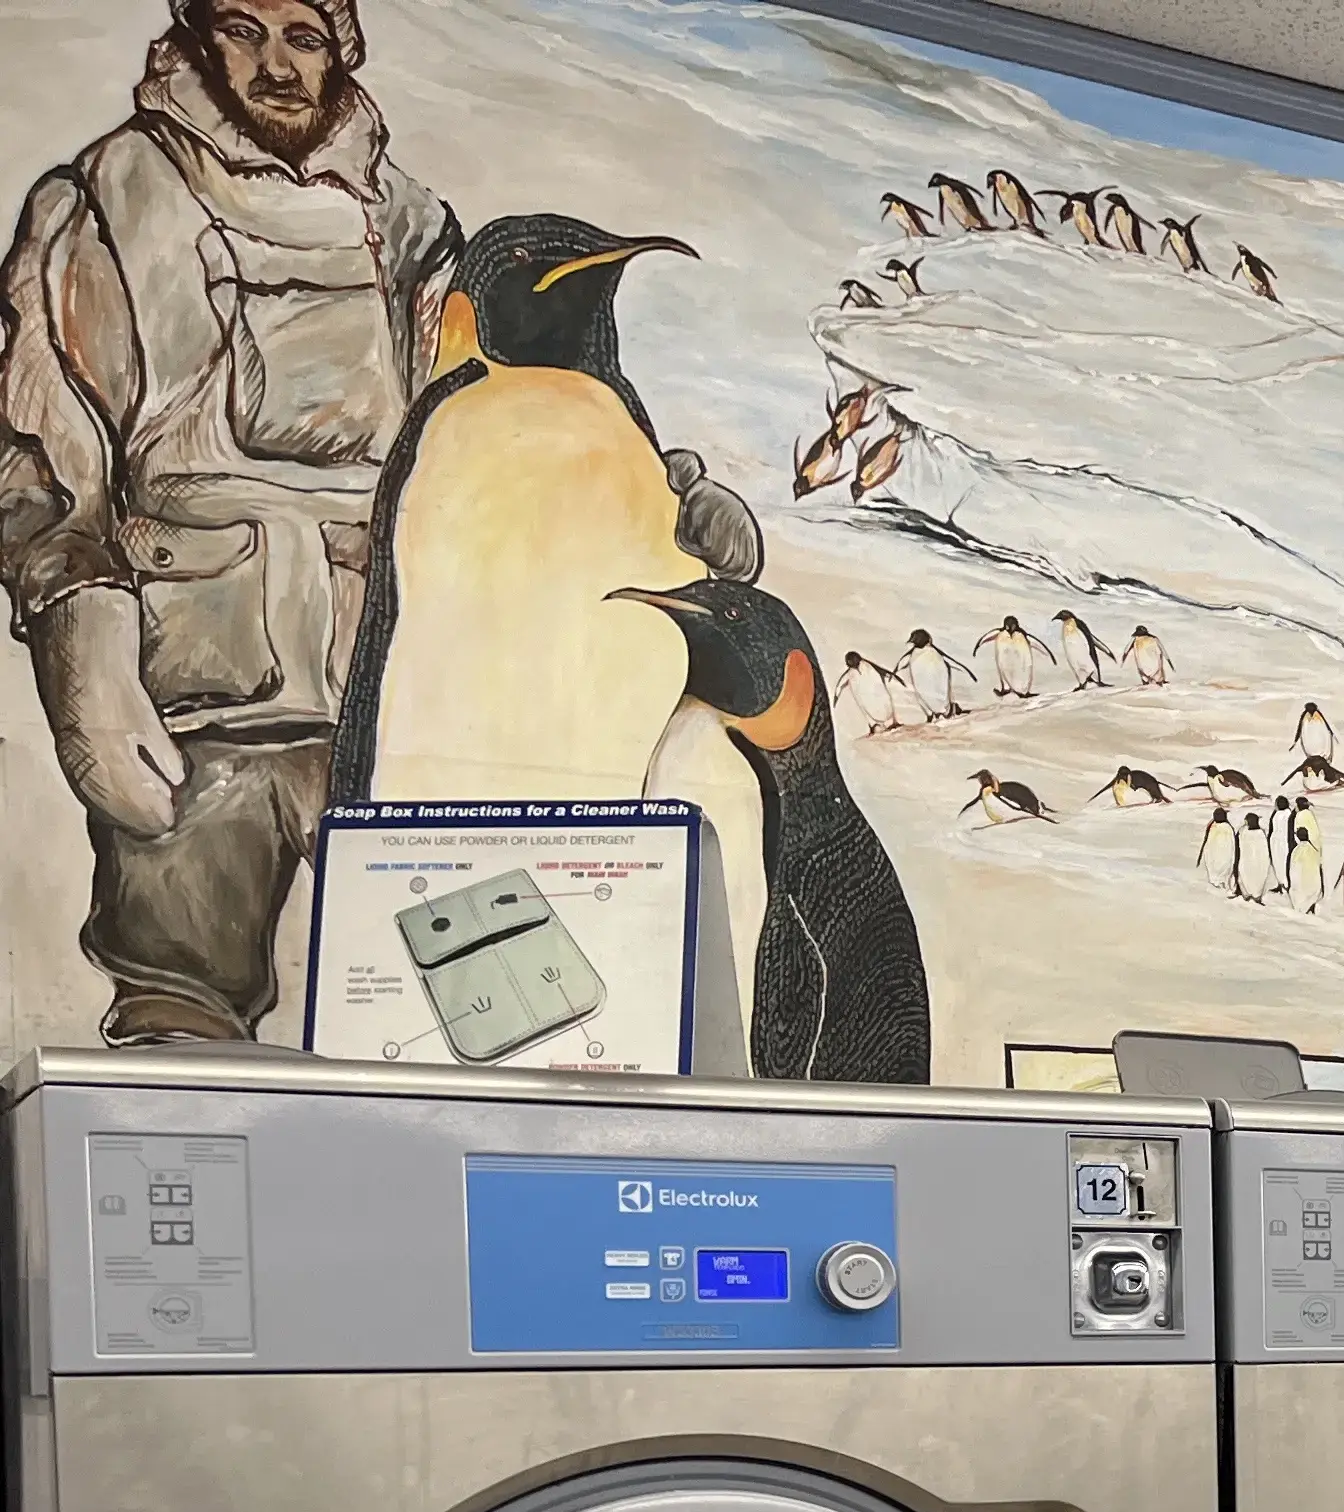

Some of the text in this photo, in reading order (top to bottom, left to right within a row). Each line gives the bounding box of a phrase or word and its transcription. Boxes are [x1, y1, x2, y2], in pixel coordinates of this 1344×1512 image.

[333, 803, 689, 820] Soap Box Instructions for a Cleaner Wash
[381, 835, 636, 846] YOU CAN USE POWDER OR LIQUID DETERGENT
[658, 1188, 759, 1208] Electrolux
[1087, 1178, 1117, 1202] 12
[844, 1260, 868, 1276] START
